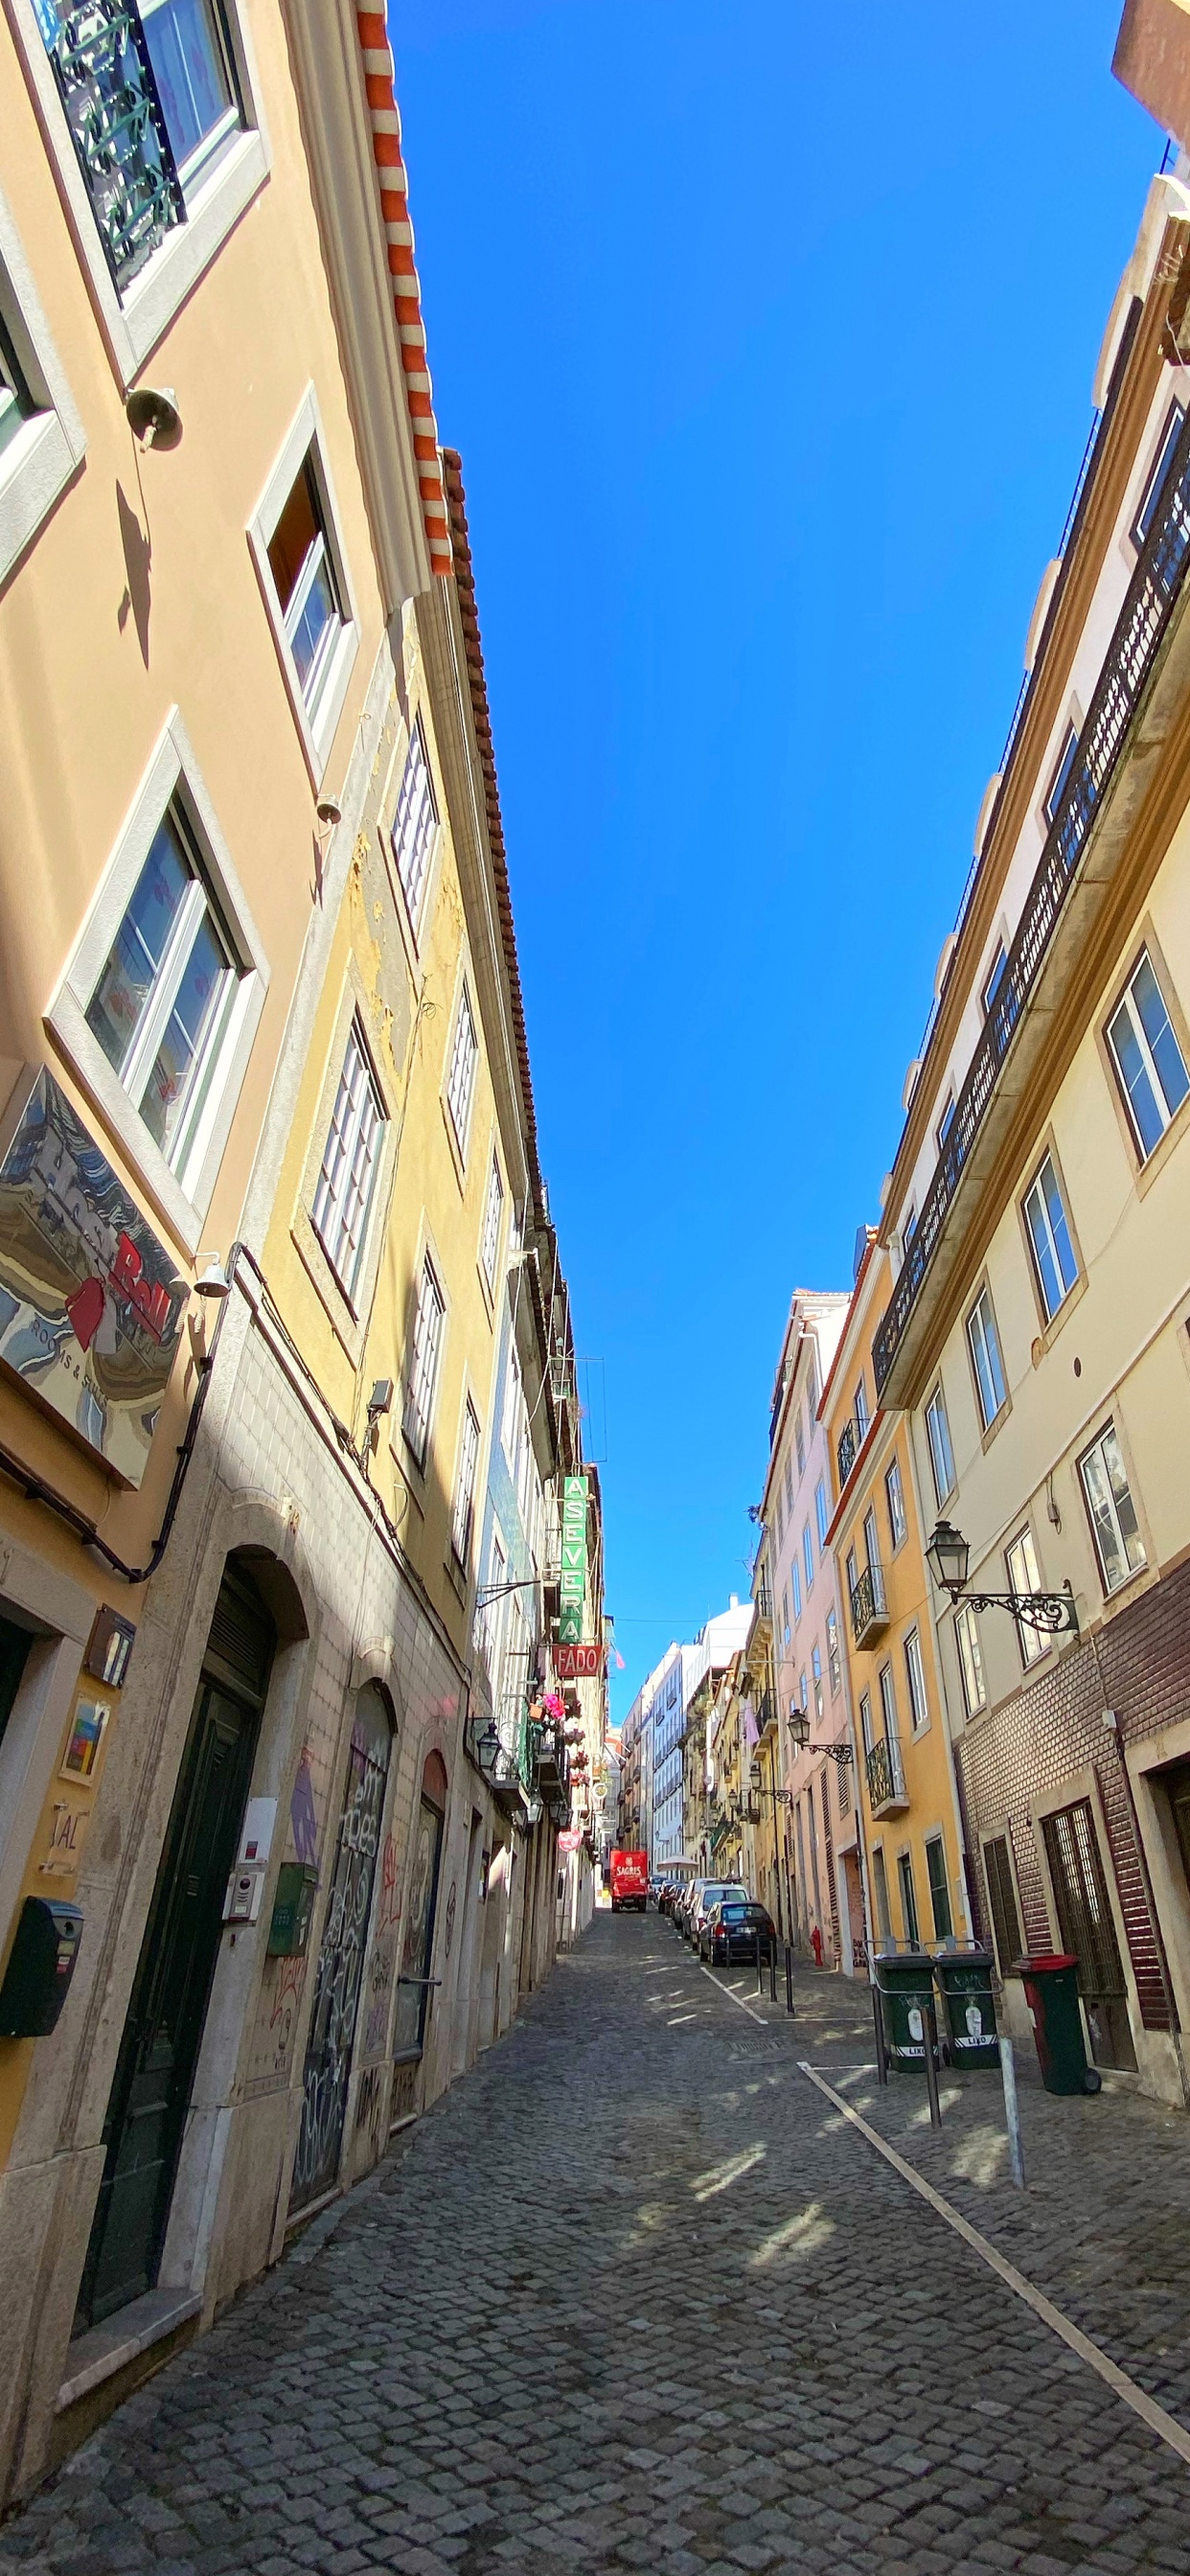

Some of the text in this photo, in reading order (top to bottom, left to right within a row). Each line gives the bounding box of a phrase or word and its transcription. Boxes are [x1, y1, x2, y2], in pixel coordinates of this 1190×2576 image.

[559, 1649, 597, 1672] FADO
[616, 1866, 641, 1876] SAGRES
[968, 2036, 987, 2045] LIXO
